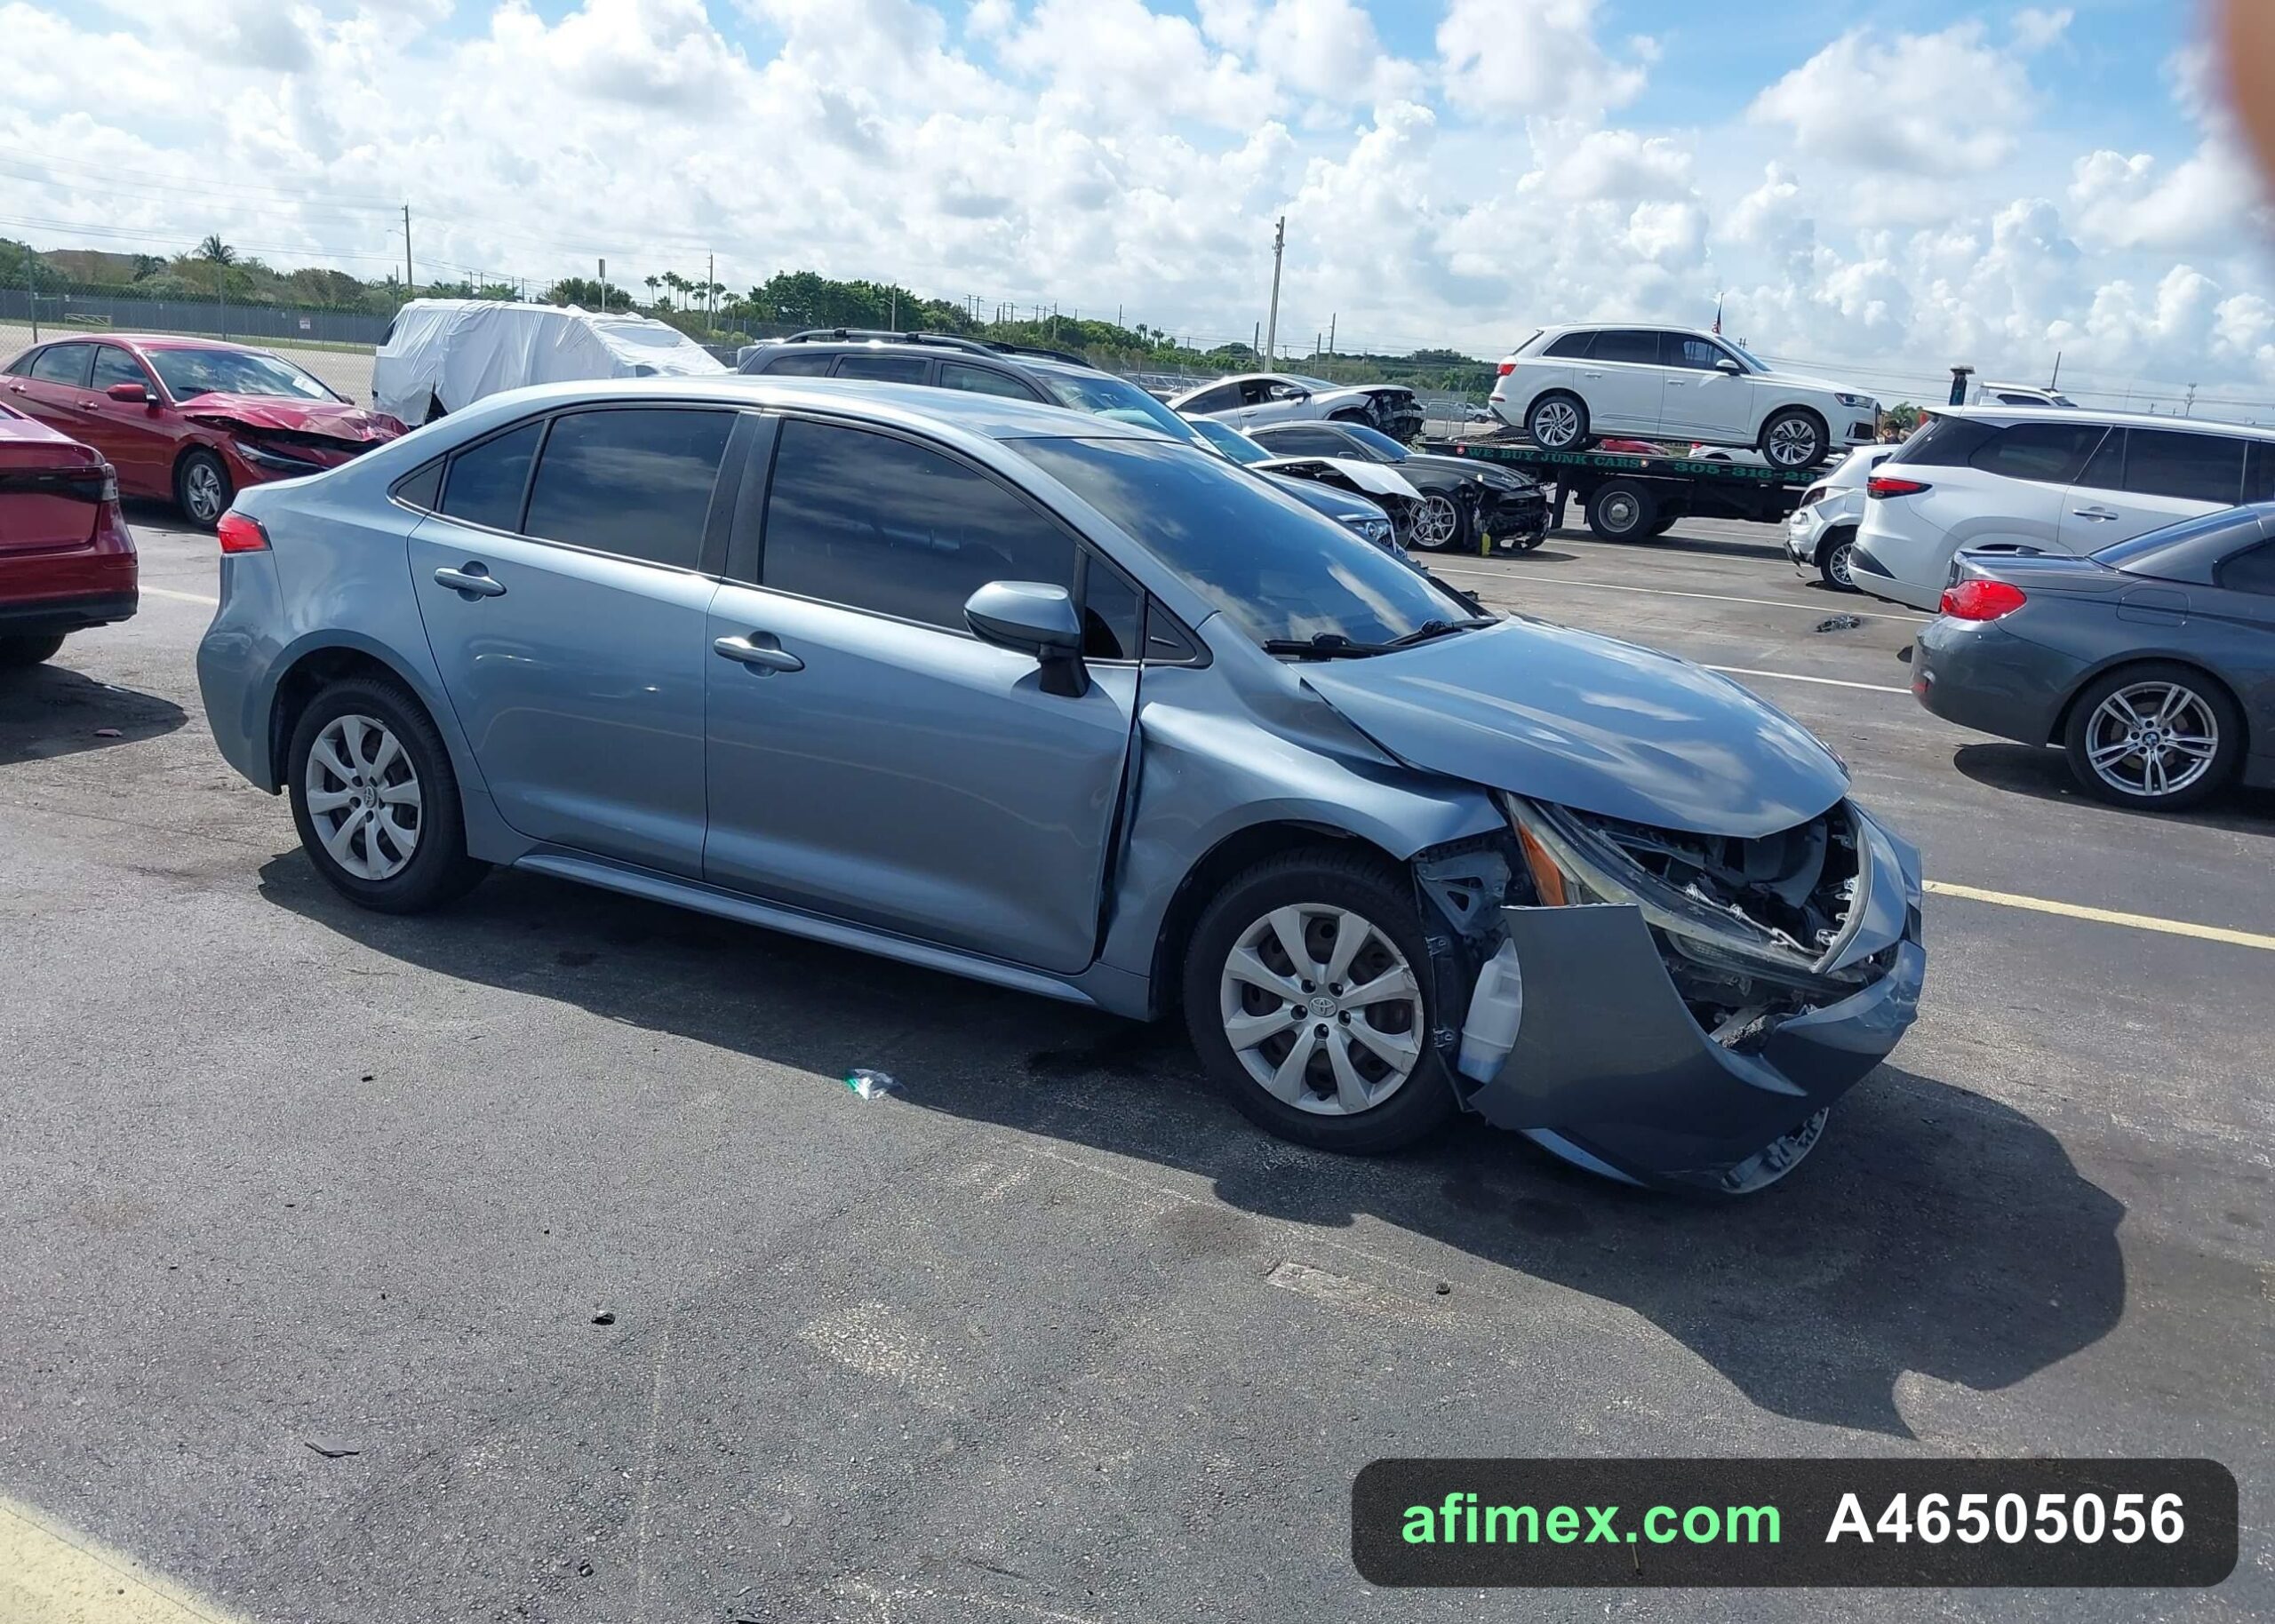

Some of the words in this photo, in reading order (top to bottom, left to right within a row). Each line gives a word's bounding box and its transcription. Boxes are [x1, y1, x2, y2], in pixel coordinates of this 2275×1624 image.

[1467, 448, 1494, 458] WE
[1500, 449, 1536, 462] BUY
[1541, 452, 1587, 466] JUNK
[1594, 457, 1640, 469] CARS
